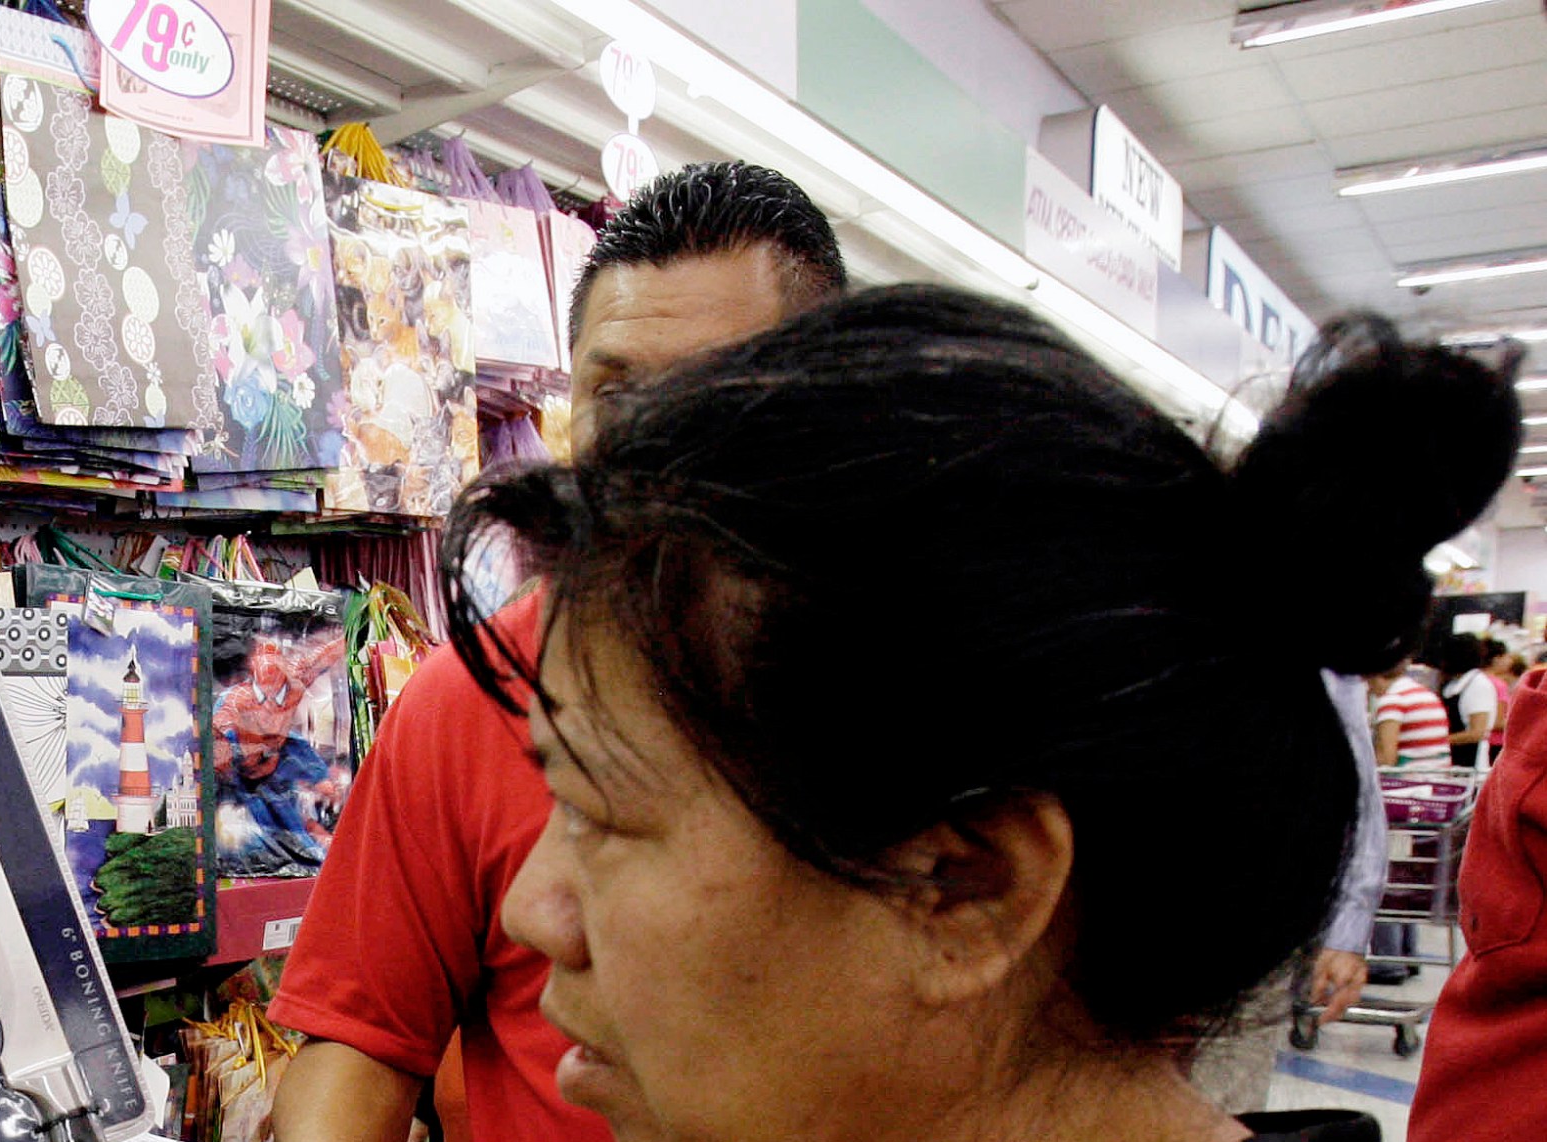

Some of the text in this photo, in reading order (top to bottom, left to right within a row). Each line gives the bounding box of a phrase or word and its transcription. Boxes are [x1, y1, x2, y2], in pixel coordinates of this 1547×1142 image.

[169, 48, 210, 74] only
[69, 950, 112, 1037] BONING
[106, 1046, 138, 1110] KNIFE
